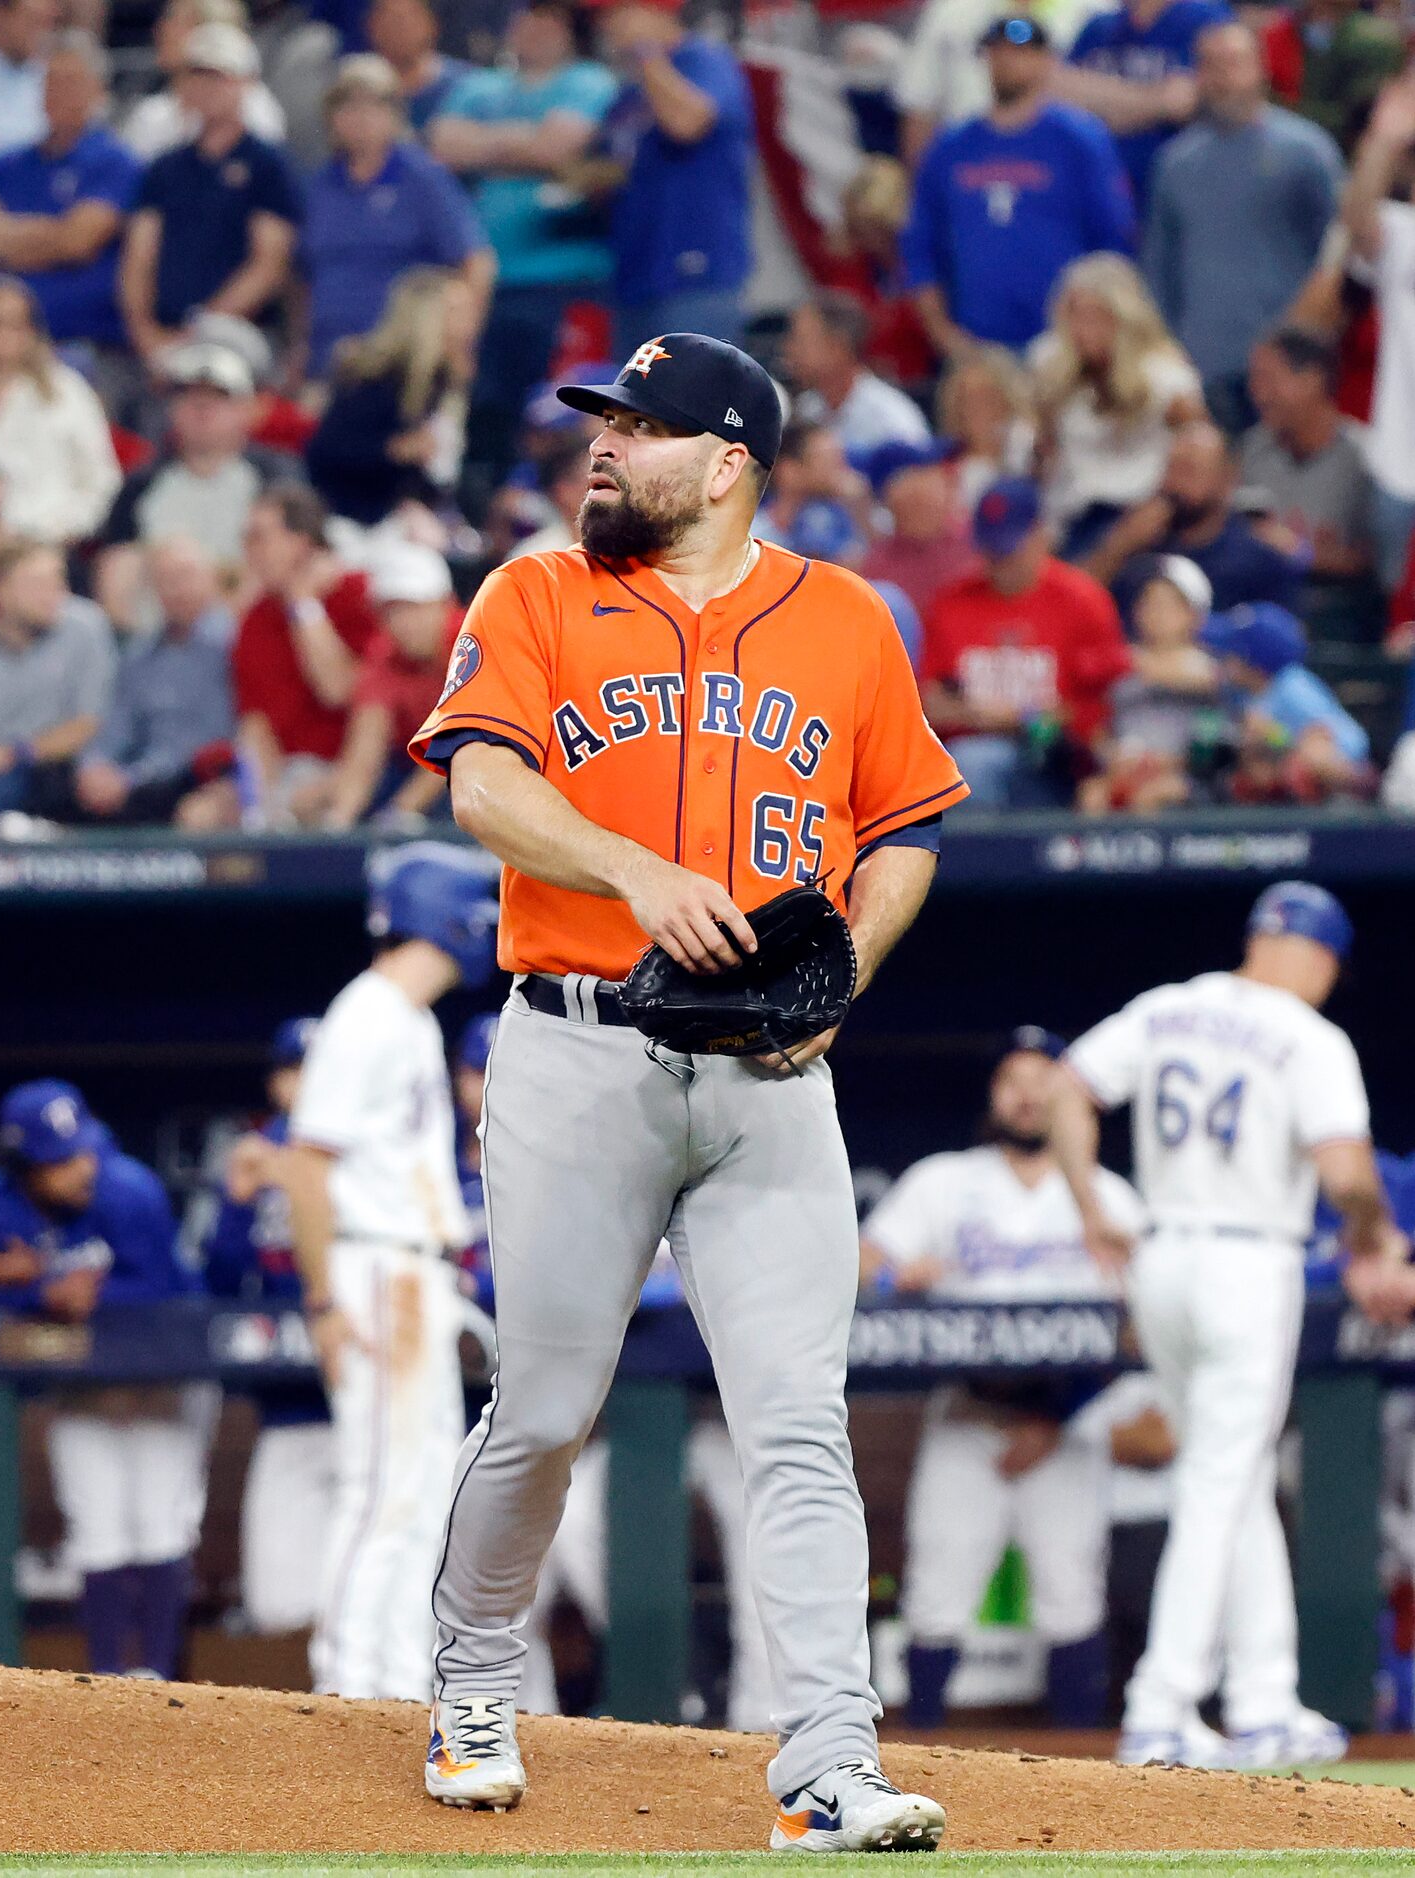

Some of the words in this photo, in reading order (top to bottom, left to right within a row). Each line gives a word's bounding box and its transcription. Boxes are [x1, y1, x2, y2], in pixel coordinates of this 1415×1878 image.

[552, 672, 832, 780] ASTROS
[750, 791, 827, 885] 65
[1155, 1059, 1247, 1150] 64
